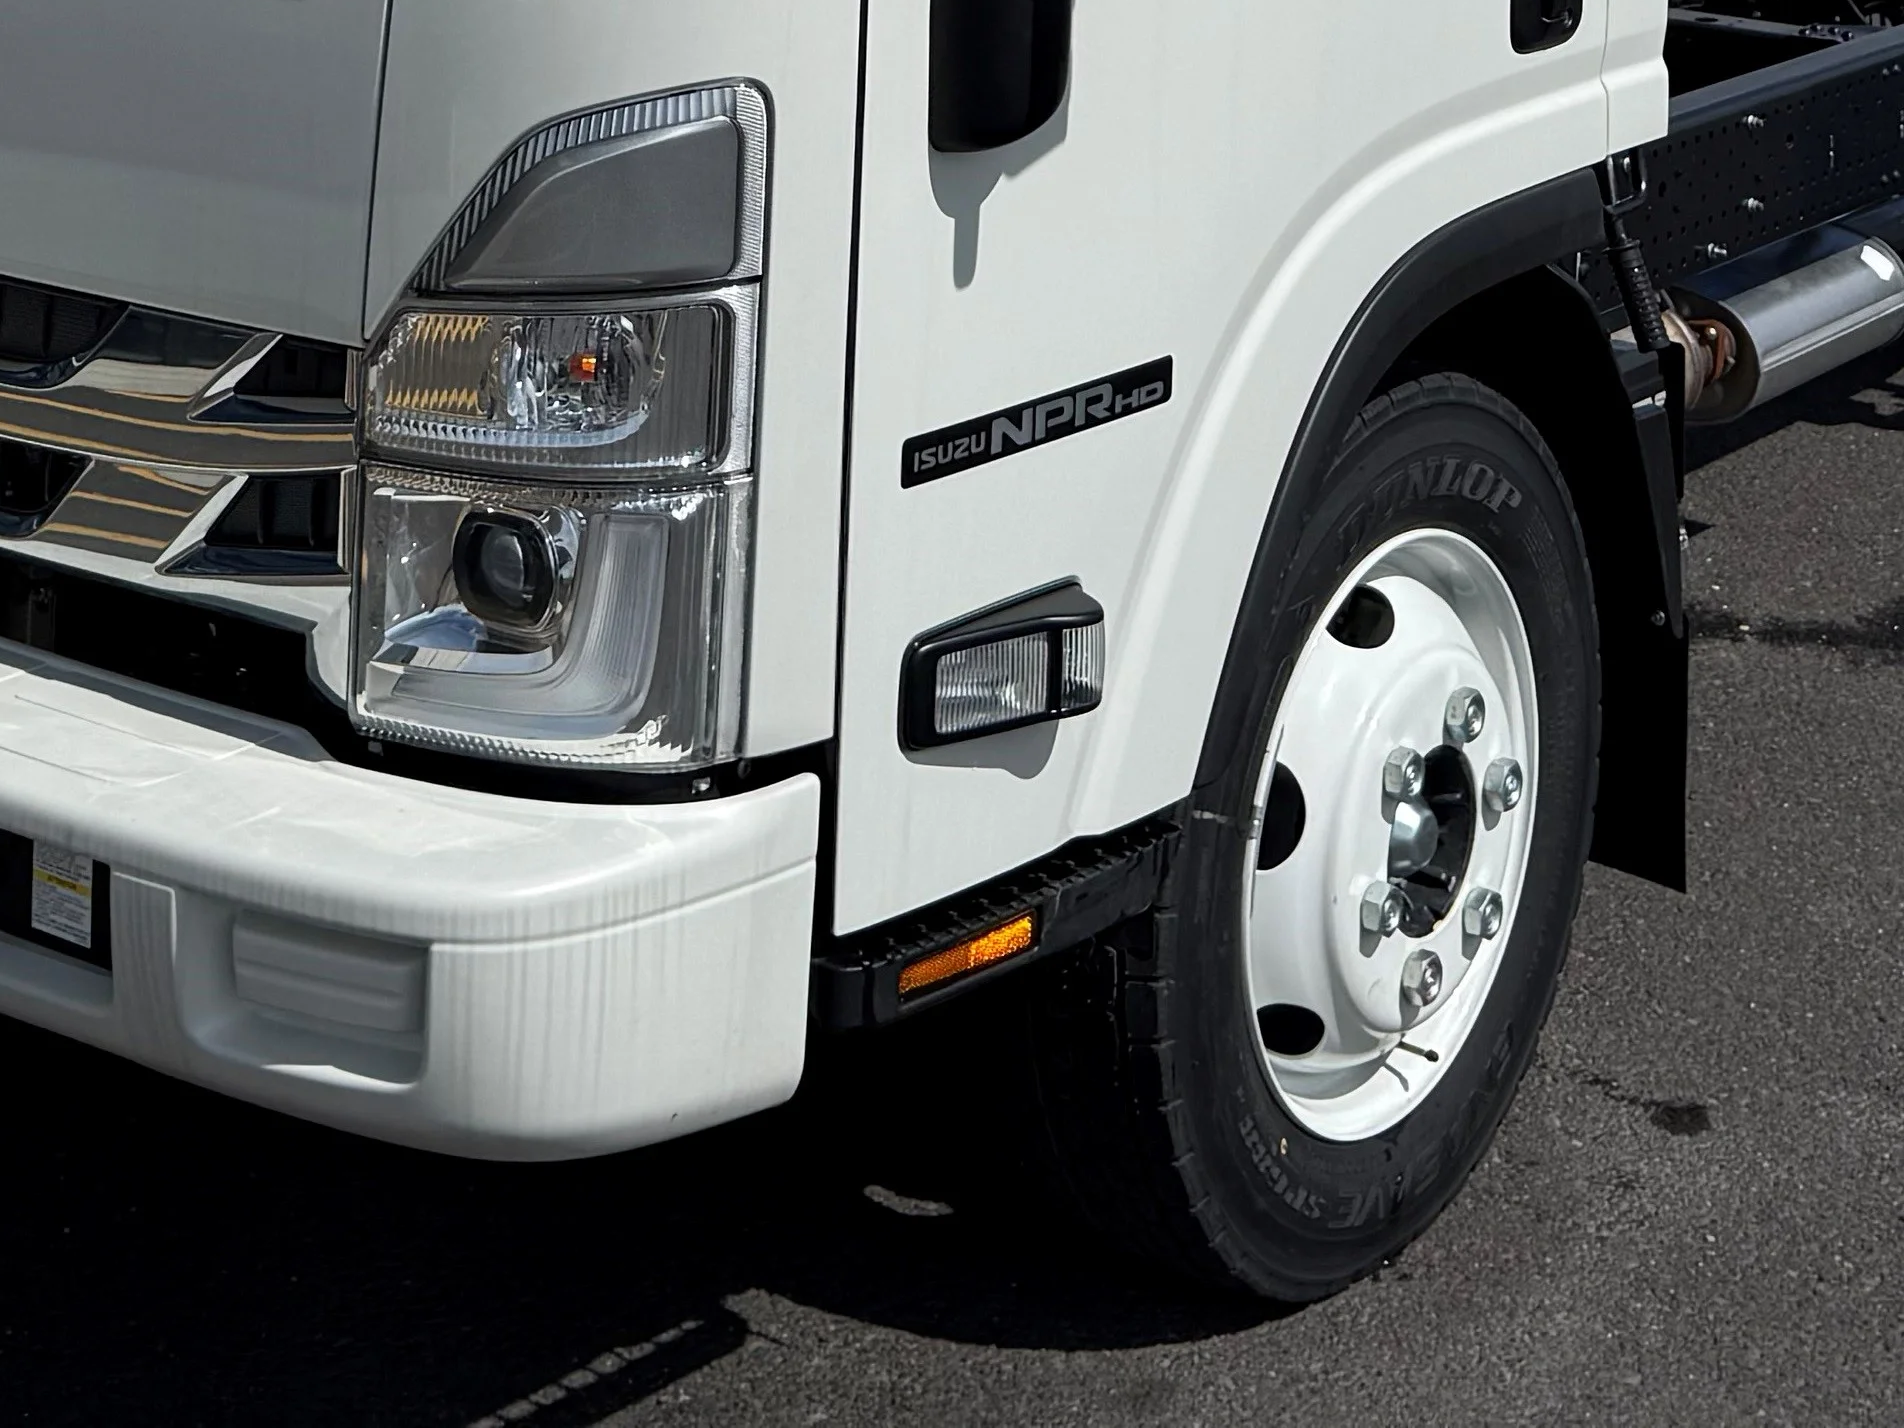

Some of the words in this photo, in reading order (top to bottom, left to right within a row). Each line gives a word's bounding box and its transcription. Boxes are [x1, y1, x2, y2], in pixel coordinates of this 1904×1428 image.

[913, 431, 986, 473] ISUZU
[990, 382, 1113, 455] NPR
[1114, 380, 1164, 415] HD
